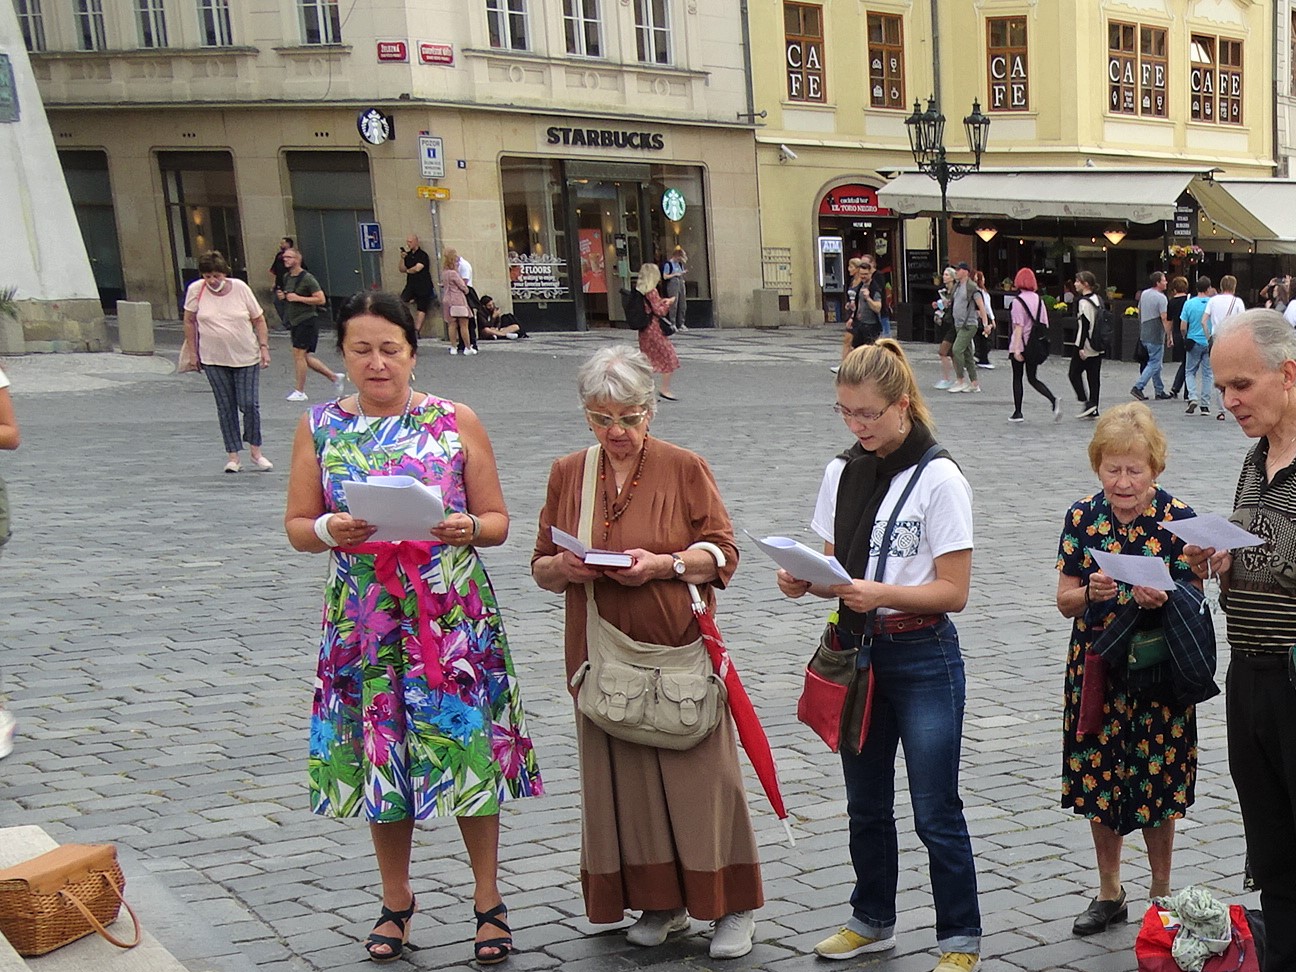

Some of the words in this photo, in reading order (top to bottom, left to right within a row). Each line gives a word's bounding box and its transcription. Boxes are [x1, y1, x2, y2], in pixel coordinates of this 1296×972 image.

[547, 127, 664, 150] STARBUCKS
[823, 241, 840, 249] ATM
[525, 266, 551, 274] FLOORS
